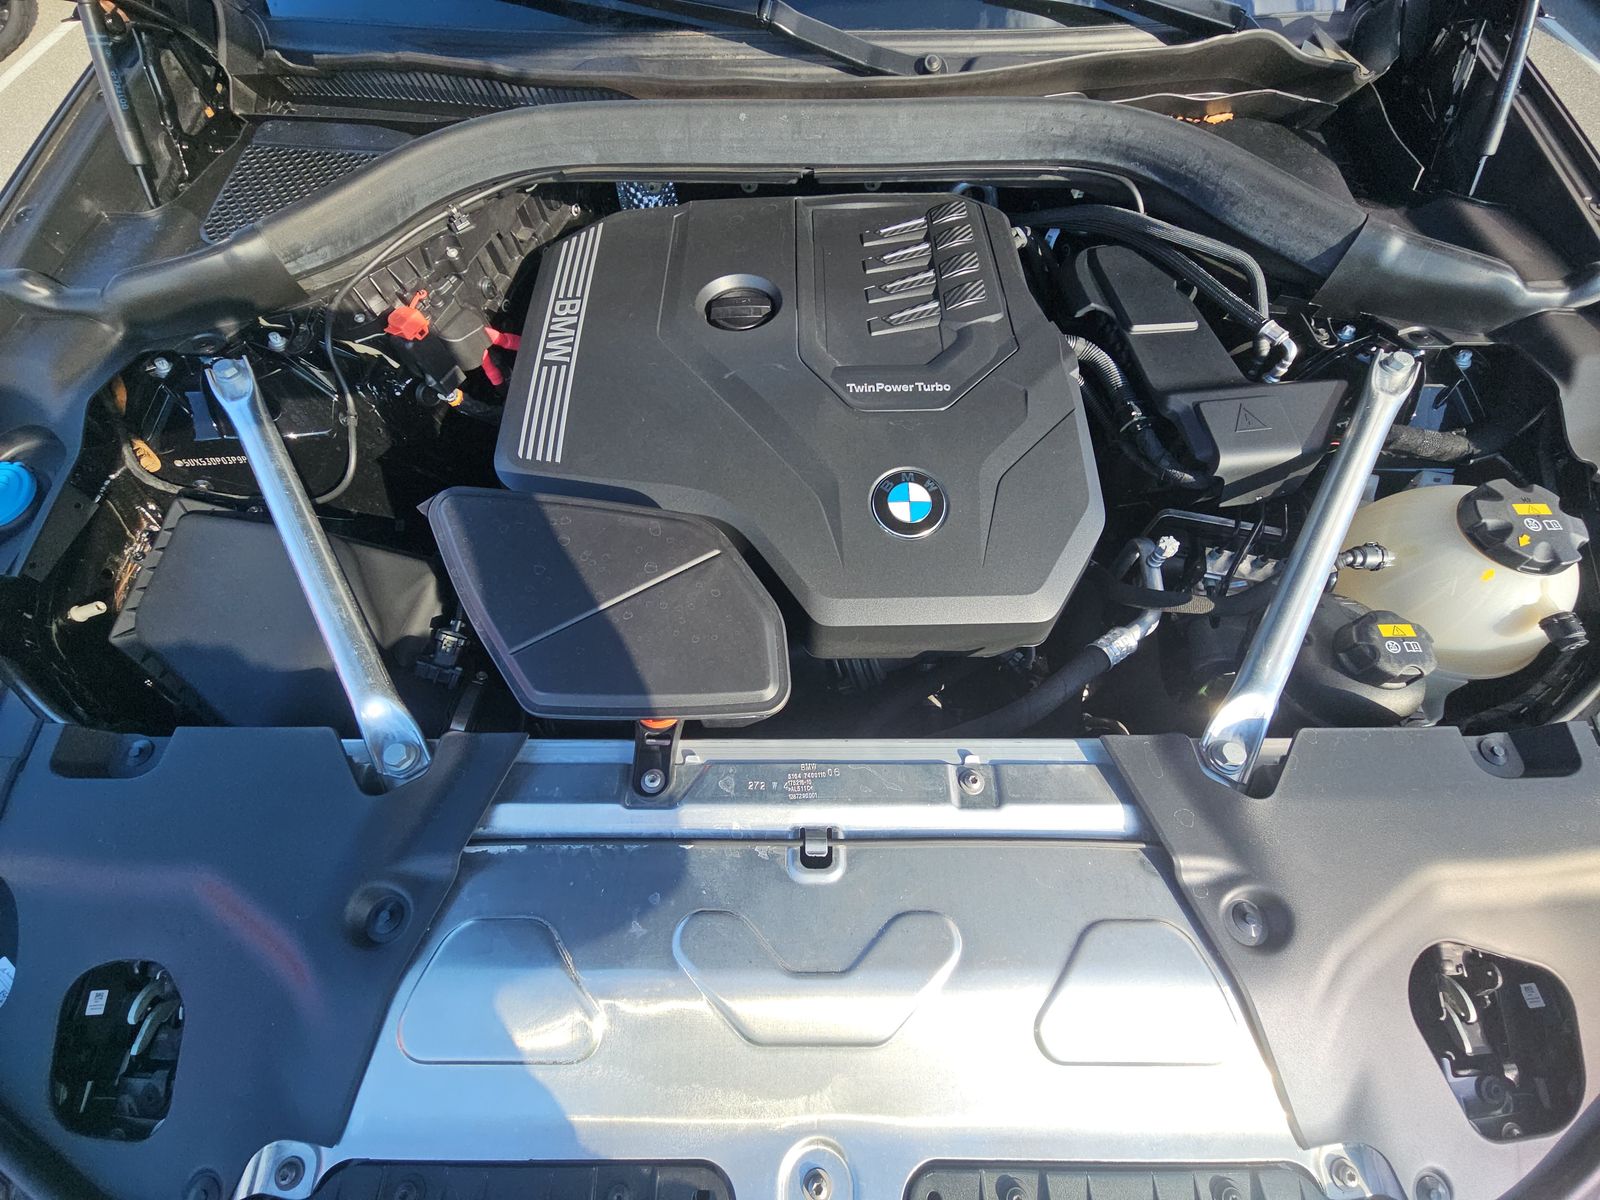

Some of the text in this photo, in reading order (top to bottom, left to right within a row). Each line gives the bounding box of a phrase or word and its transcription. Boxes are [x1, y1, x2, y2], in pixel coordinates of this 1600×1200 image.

[543, 299, 582, 363] BMW
[846, 382, 951, 393] TwinPower Turbo
[880, 472, 938, 493] BMW
[800, 763, 817, 771] BMW
[748, 781, 766, 791] 272
